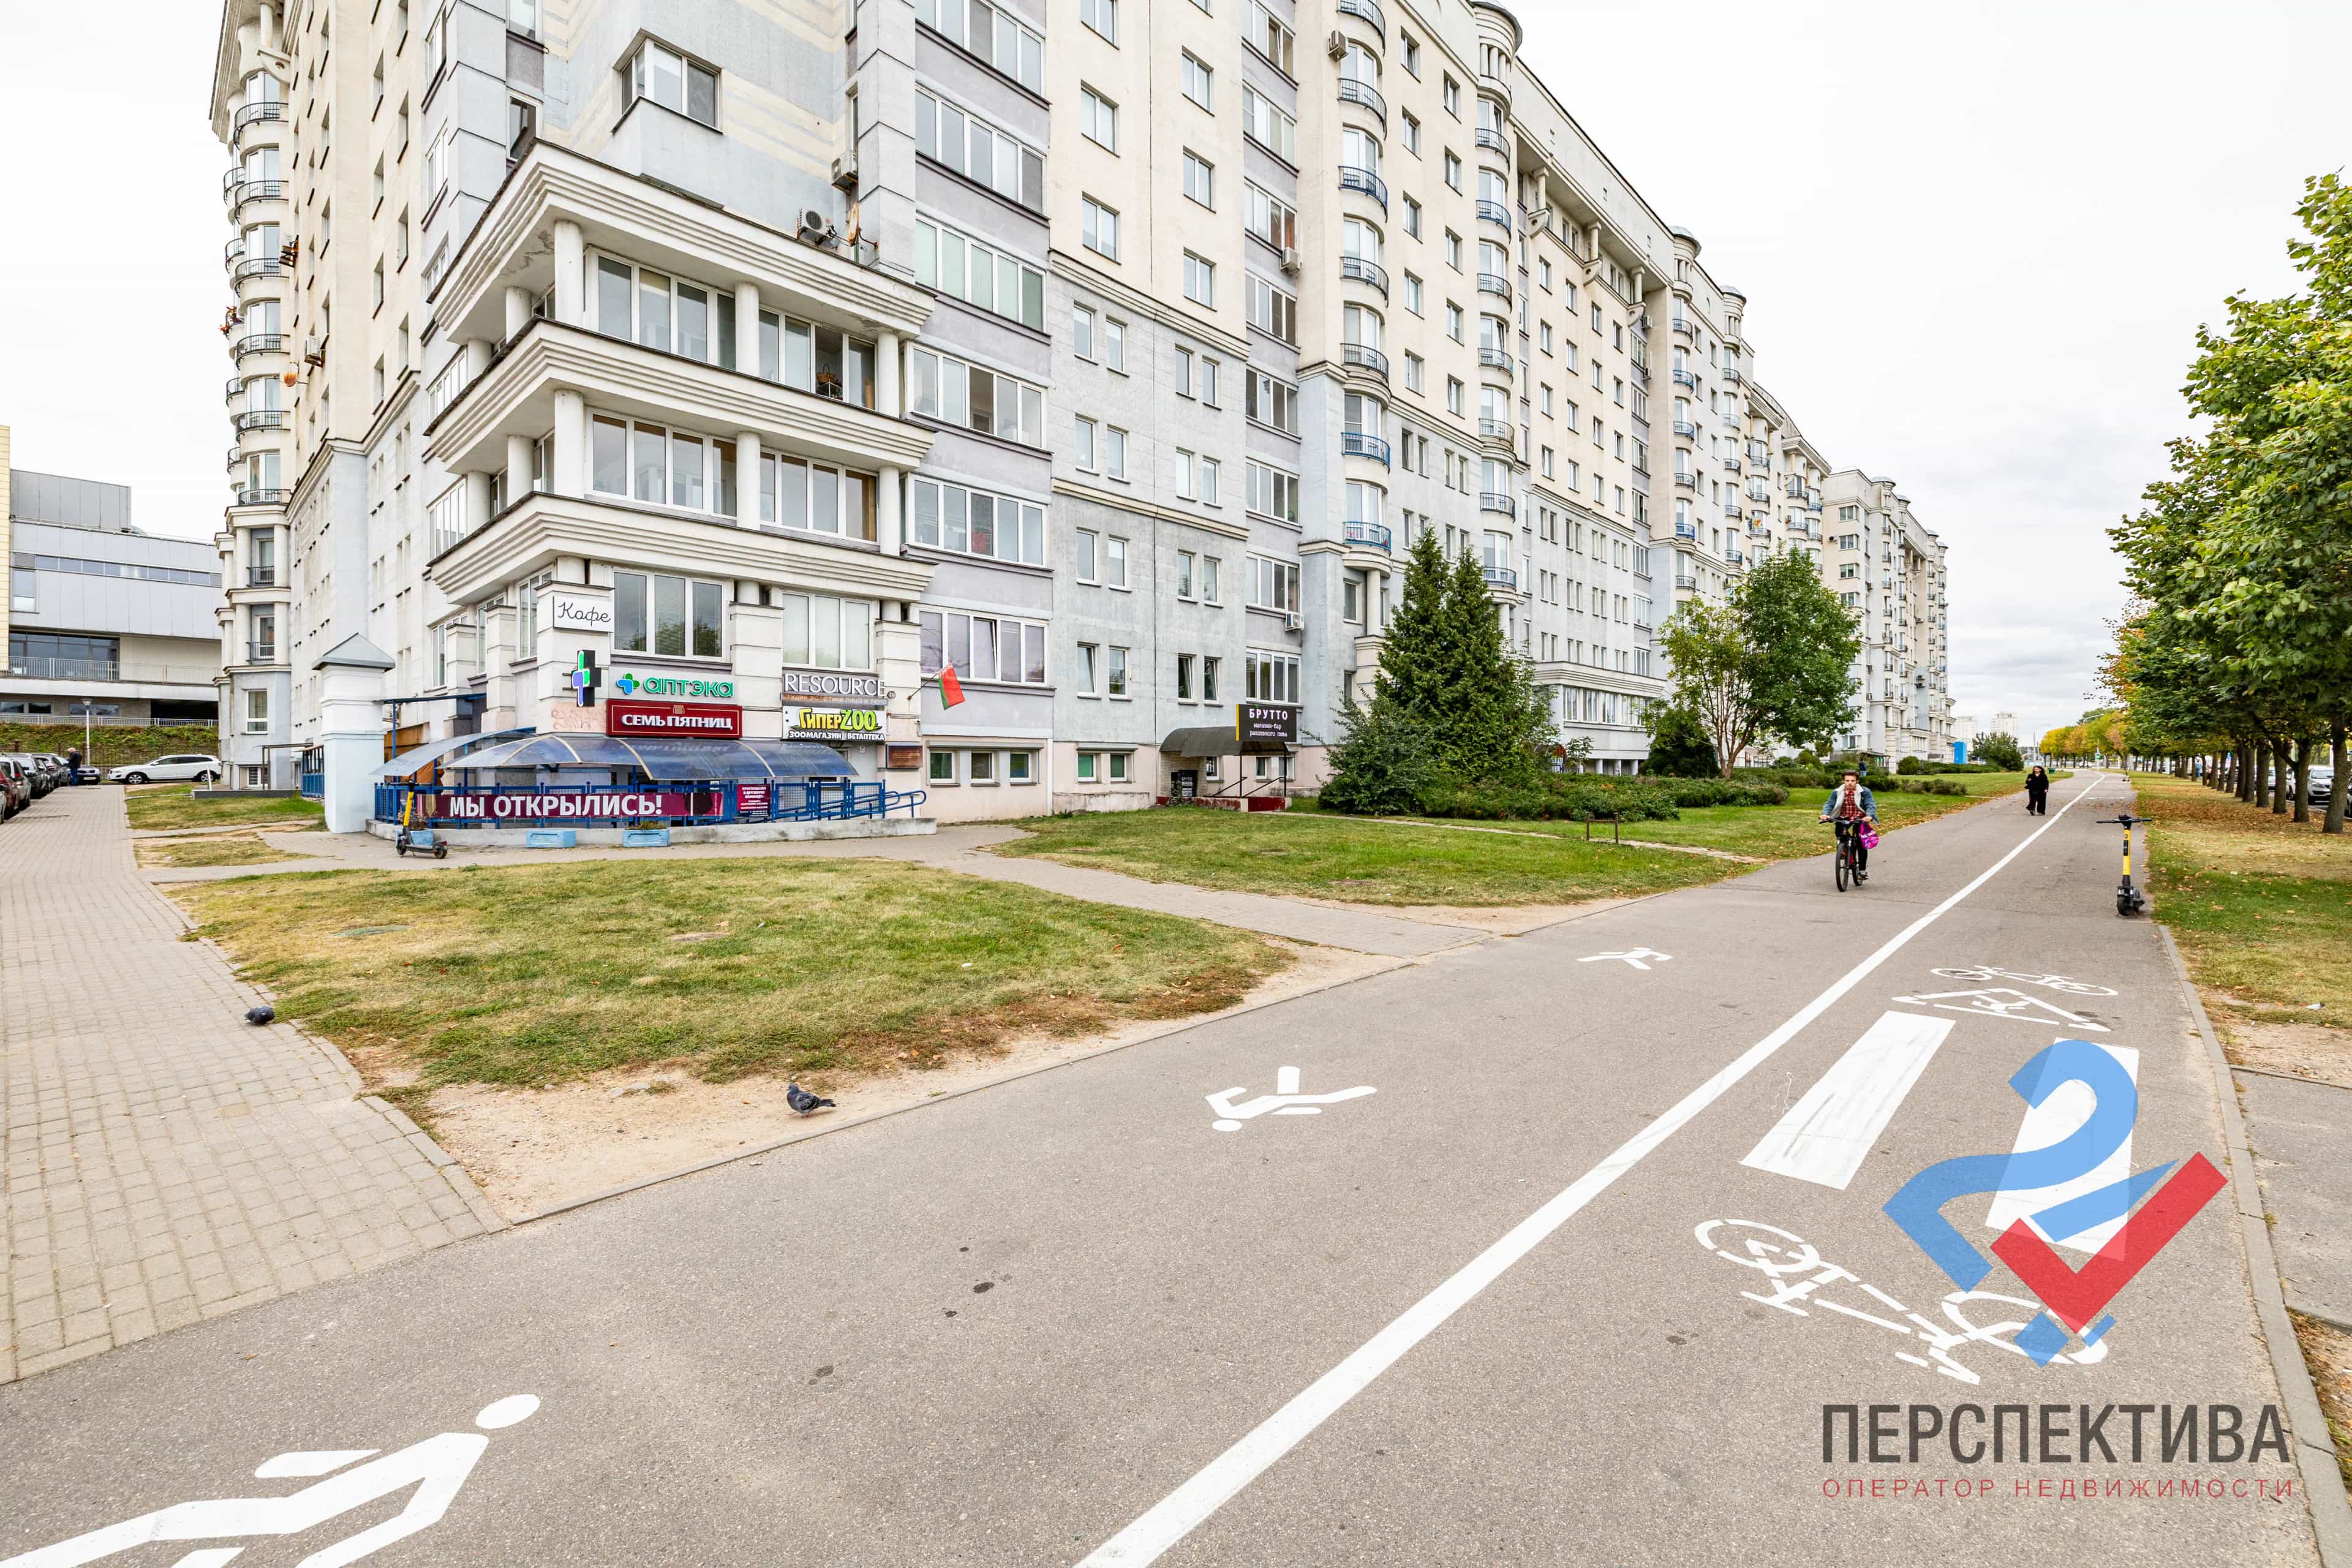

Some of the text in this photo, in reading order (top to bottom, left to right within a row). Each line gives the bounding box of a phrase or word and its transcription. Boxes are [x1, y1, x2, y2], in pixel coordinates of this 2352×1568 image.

[557, 601, 611, 627] Кафе
[784, 673, 887, 697] RESOURCE
[622, 714, 665, 728] СЕМЬ
[666, 716, 733, 730] ПЯТНИЦ
[1249, 708, 1288, 720] БРУТТО
[788, 731, 842, 740] ЗООМАГАЗИН
[450, 794, 663, 817] МЫ ОТКРЫЛИСЬ!
